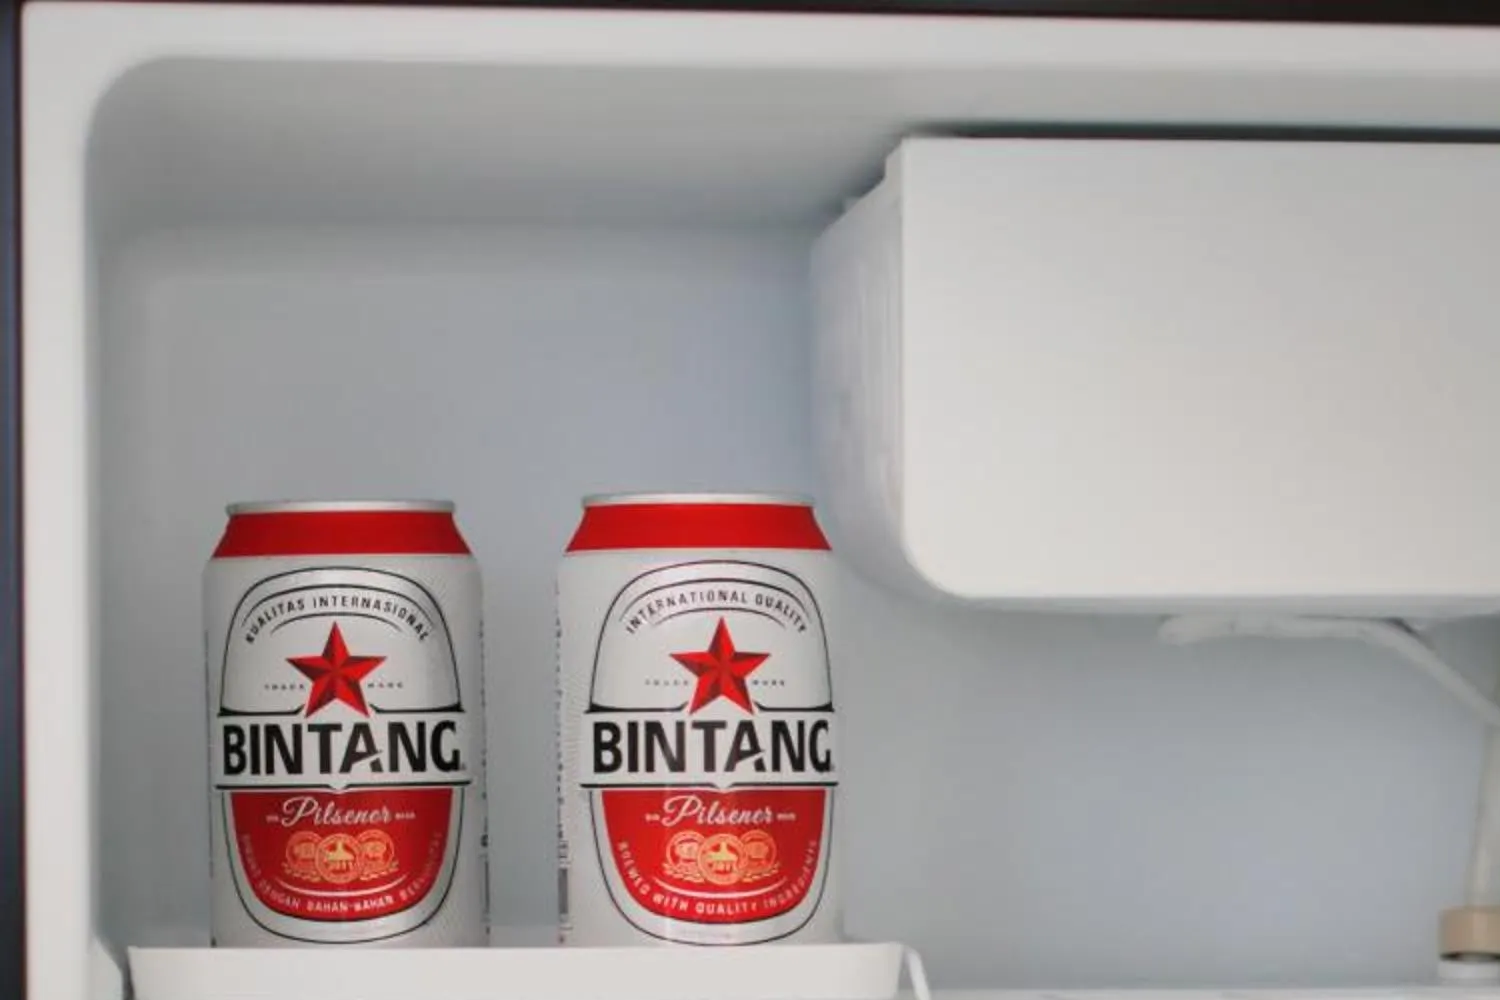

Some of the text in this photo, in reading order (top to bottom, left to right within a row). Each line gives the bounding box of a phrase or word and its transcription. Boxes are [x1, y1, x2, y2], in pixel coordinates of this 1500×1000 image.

[245, 595, 430, 644] KUALITAS INTERNASIONAL
[626, 588, 807, 634] INTERNATIONAL QUALITY
[223, 720, 460, 775] BINTANG
[593, 719, 831, 773] BINTANG
[281, 796, 392, 827] Pilsener
[661, 795, 773, 827] Pilsener
[653, 892, 689, 911] WITH
[695, 900, 758, 916] QUALITY
